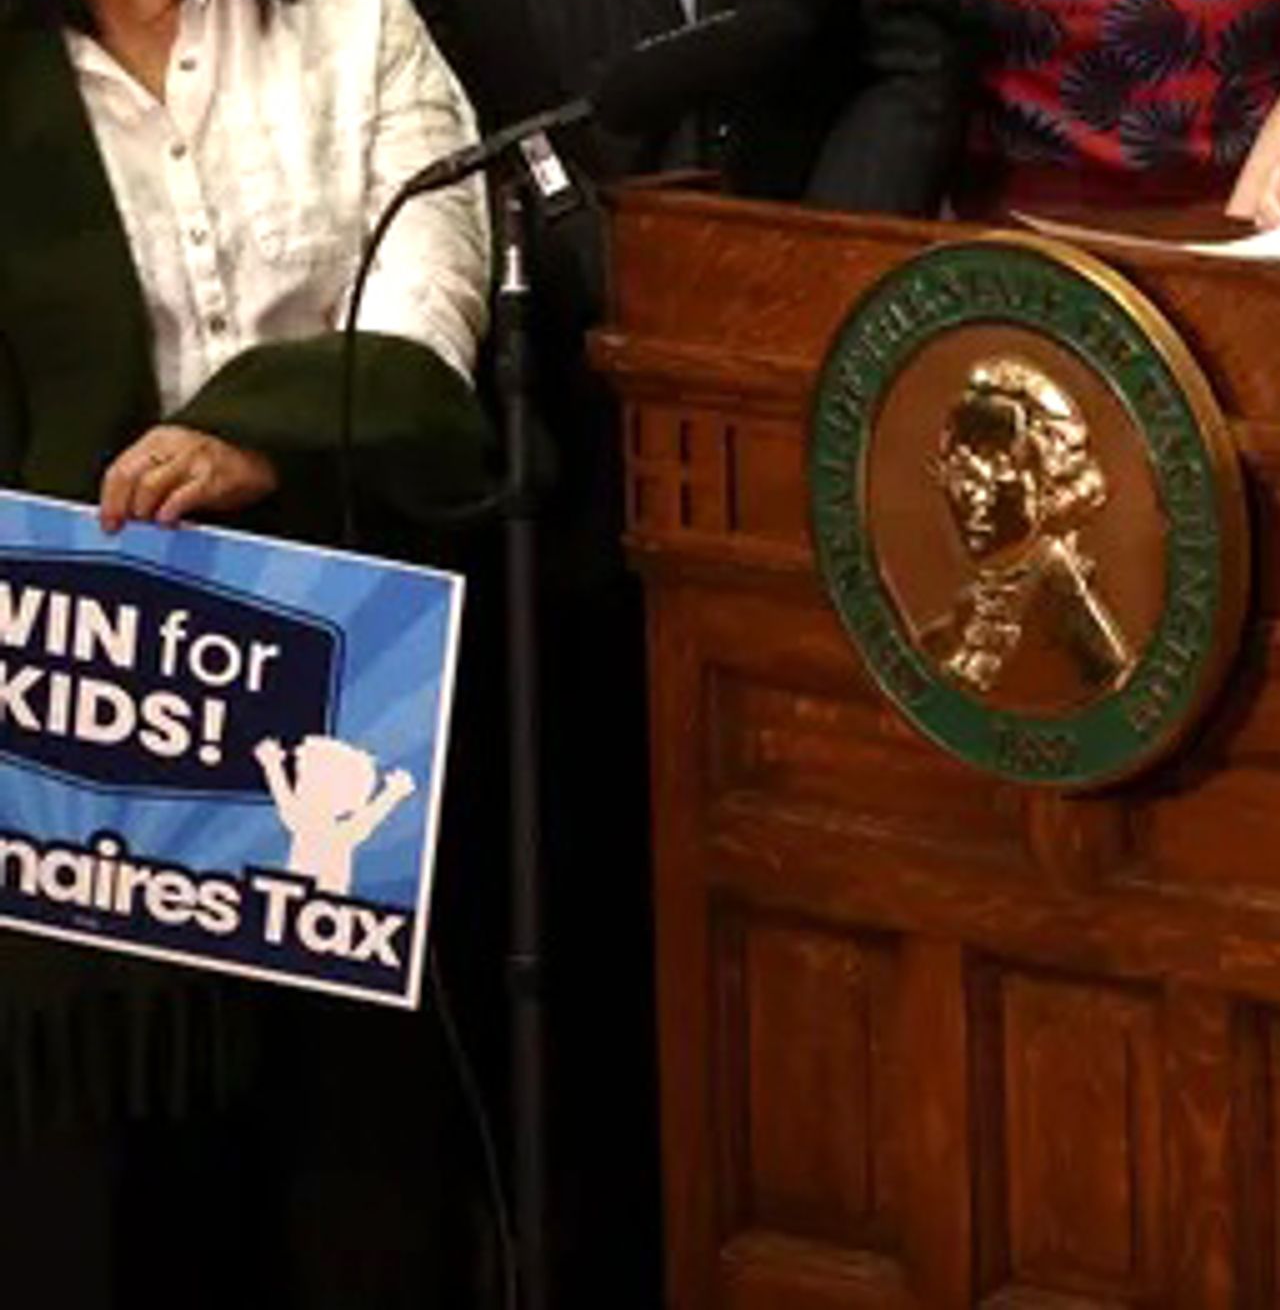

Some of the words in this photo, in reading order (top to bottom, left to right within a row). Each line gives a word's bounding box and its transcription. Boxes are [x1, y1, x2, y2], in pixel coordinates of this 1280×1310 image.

[157, 609, 281, 693] for
[0, 658, 228, 766] KIDS!
[0, 836, 242, 935] naires
[252, 874, 409, 968] Tax
